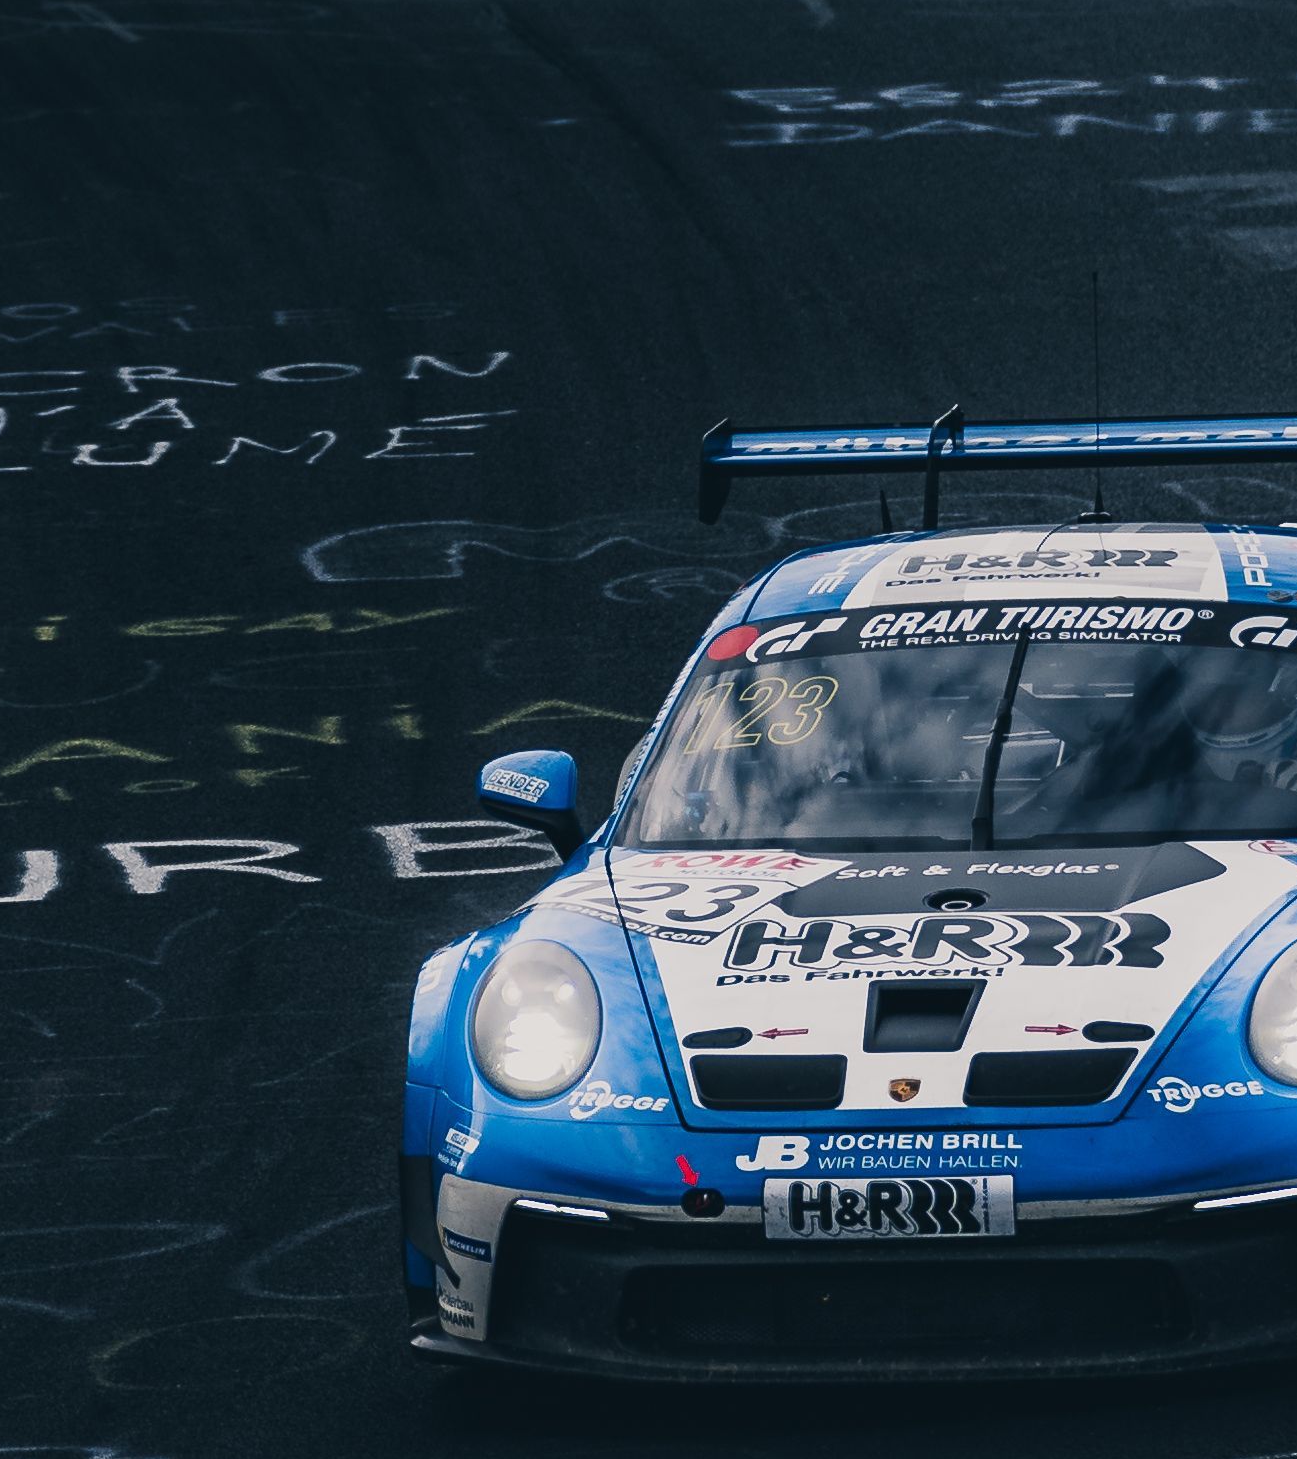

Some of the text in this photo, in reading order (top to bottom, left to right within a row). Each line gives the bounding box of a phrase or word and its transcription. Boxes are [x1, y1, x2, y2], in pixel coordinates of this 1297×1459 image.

[884, 571, 1101, 587] Das Fahrwerk!
[858, 607, 988, 641] GRAN
[857, 631, 1182, 650] THE REAL DRIVING SIMULATOR
[683, 675, 839, 756] 123
[487, 769, 549, 798] BENDER
[835, 865, 910, 880] Soft
[922, 865, 952, 877] &
[555, 880, 761, 923] 123
[724, 913, 1171, 973] H&R
[716, 966, 1004, 988] Das Fahrwerk!
[1146, 1078, 1265, 1110] TRUGGE
[735, 1135, 811, 1172] JB
[819, 1133, 1023, 1151] JOCHEN BRILL
[818, 1154, 1024, 1170] WIR BAUEN HALLEN.
[788, 1179, 981, 1237] H&R
[448, 1237, 486, 1256] MICHELIN
